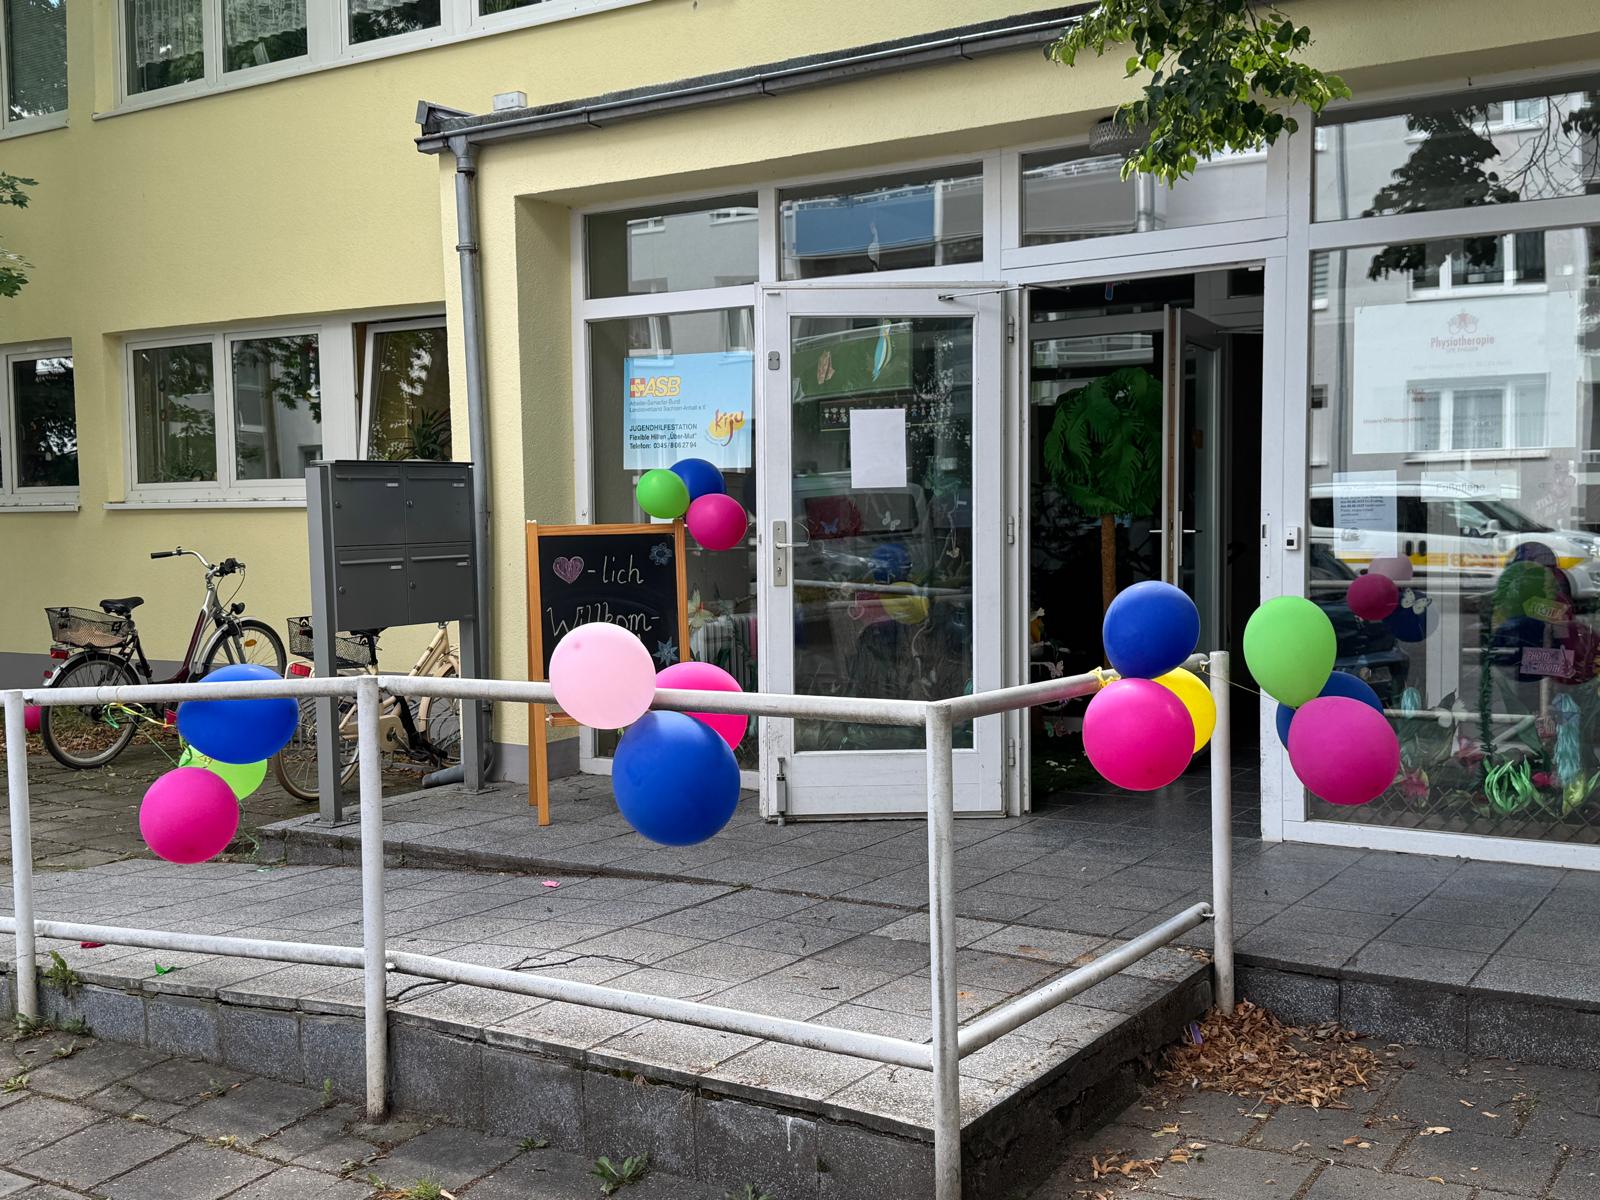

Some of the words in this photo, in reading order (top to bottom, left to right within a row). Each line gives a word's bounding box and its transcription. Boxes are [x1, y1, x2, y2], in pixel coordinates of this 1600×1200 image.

[645, 376, 682, 397] ASB
[629, 423, 698, 432] JUGENDHILFESTATION
[714, 408, 744, 447] kiju
[629, 433, 650, 441] Flexible
[629, 442, 652, 450] Telefon:
